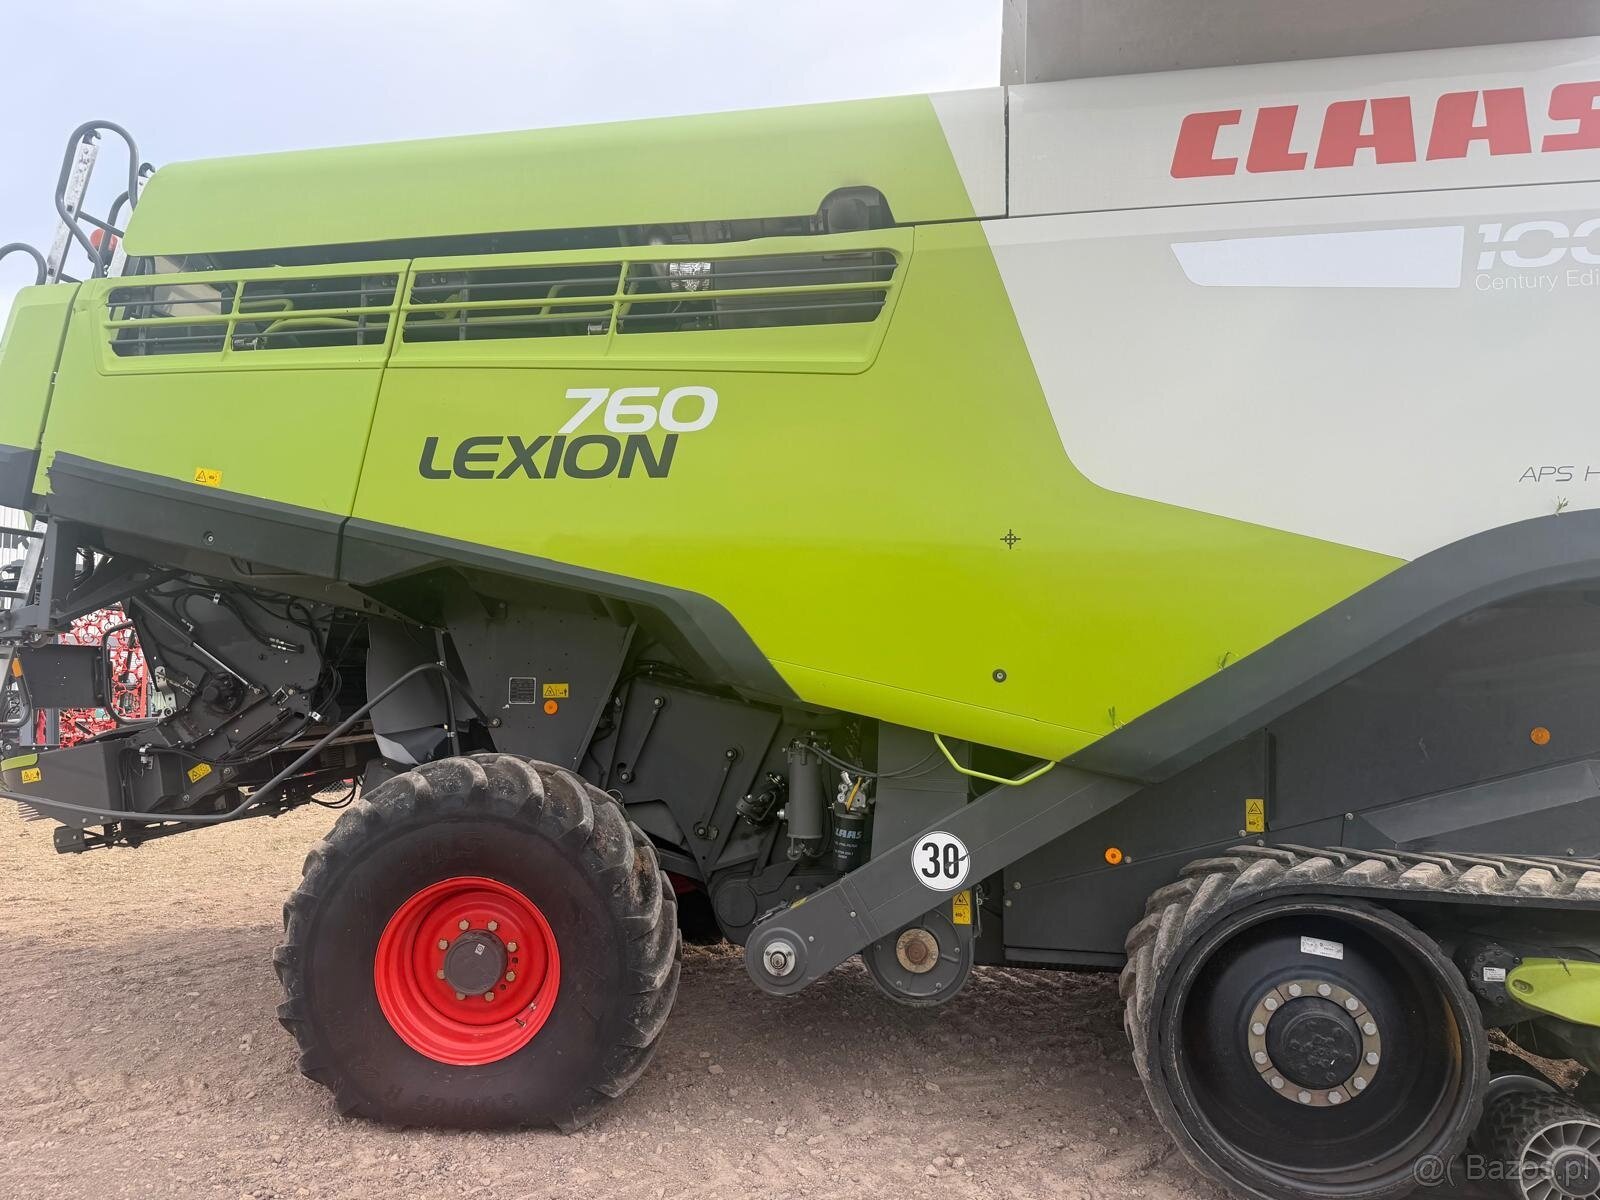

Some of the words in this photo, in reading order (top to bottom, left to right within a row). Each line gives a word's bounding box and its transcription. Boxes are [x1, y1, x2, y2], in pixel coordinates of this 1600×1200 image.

[1170, 81, 1600, 178] CLAAS
[1475, 272, 1558, 291] Century
[557, 386, 719, 434] 760
[418, 433, 680, 480] LEXION
[1519, 465, 1575, 483] APS
[921, 842, 960, 879] 30
